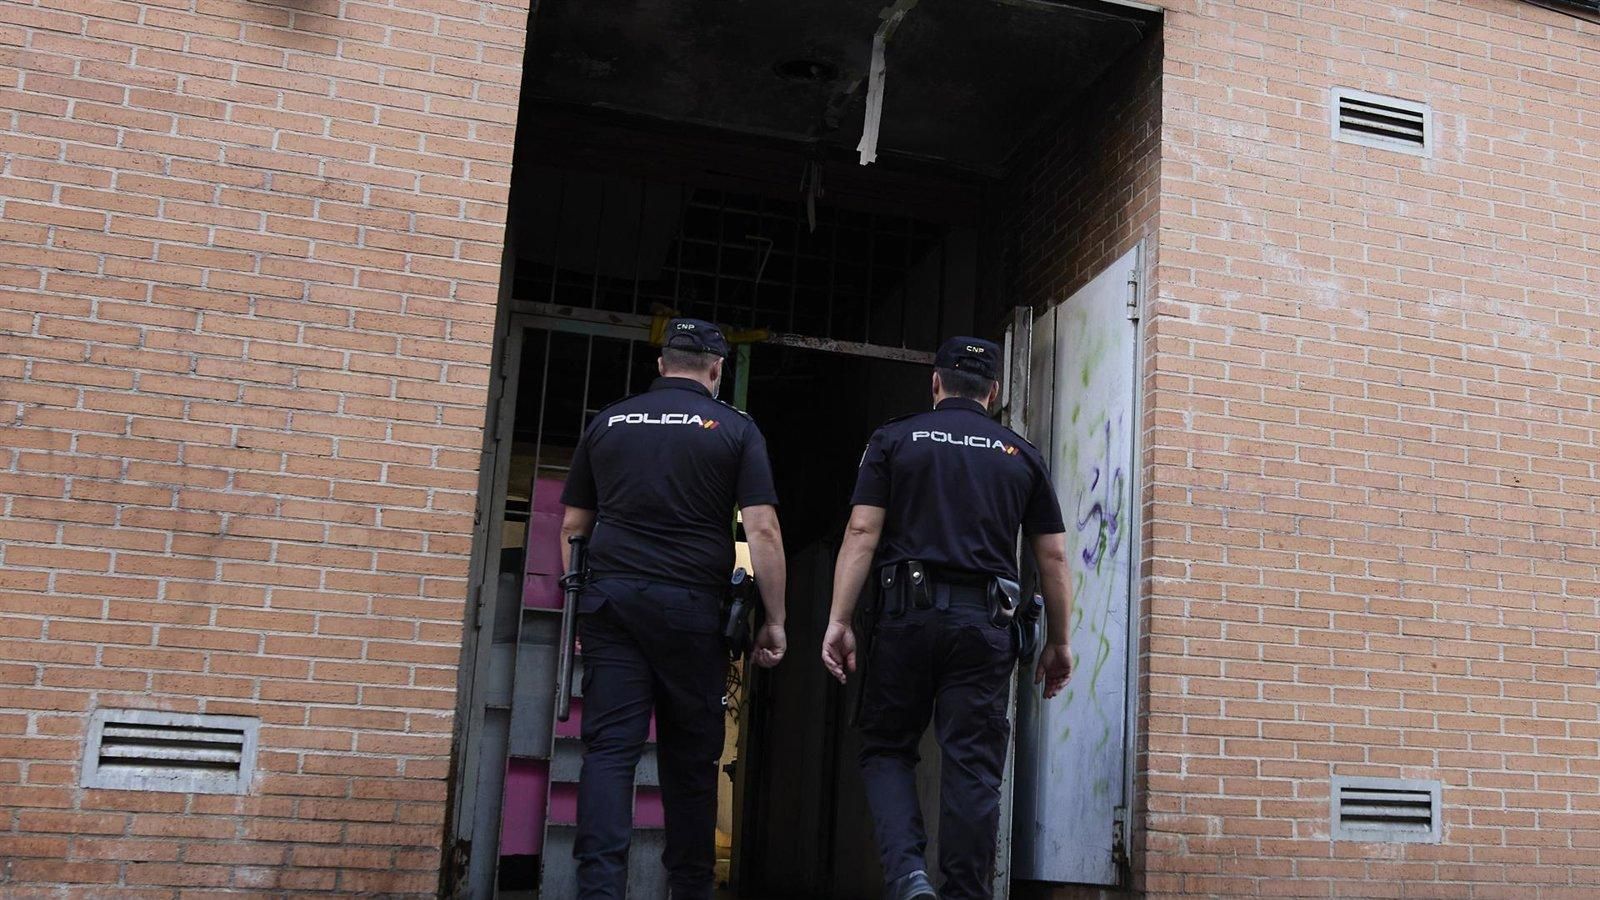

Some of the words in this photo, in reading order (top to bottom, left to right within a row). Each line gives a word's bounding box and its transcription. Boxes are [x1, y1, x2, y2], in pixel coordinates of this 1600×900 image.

[966, 345, 985, 354] CNP
[607, 413, 704, 427] POLICIA
[912, 431, 1007, 451] POLICIA
